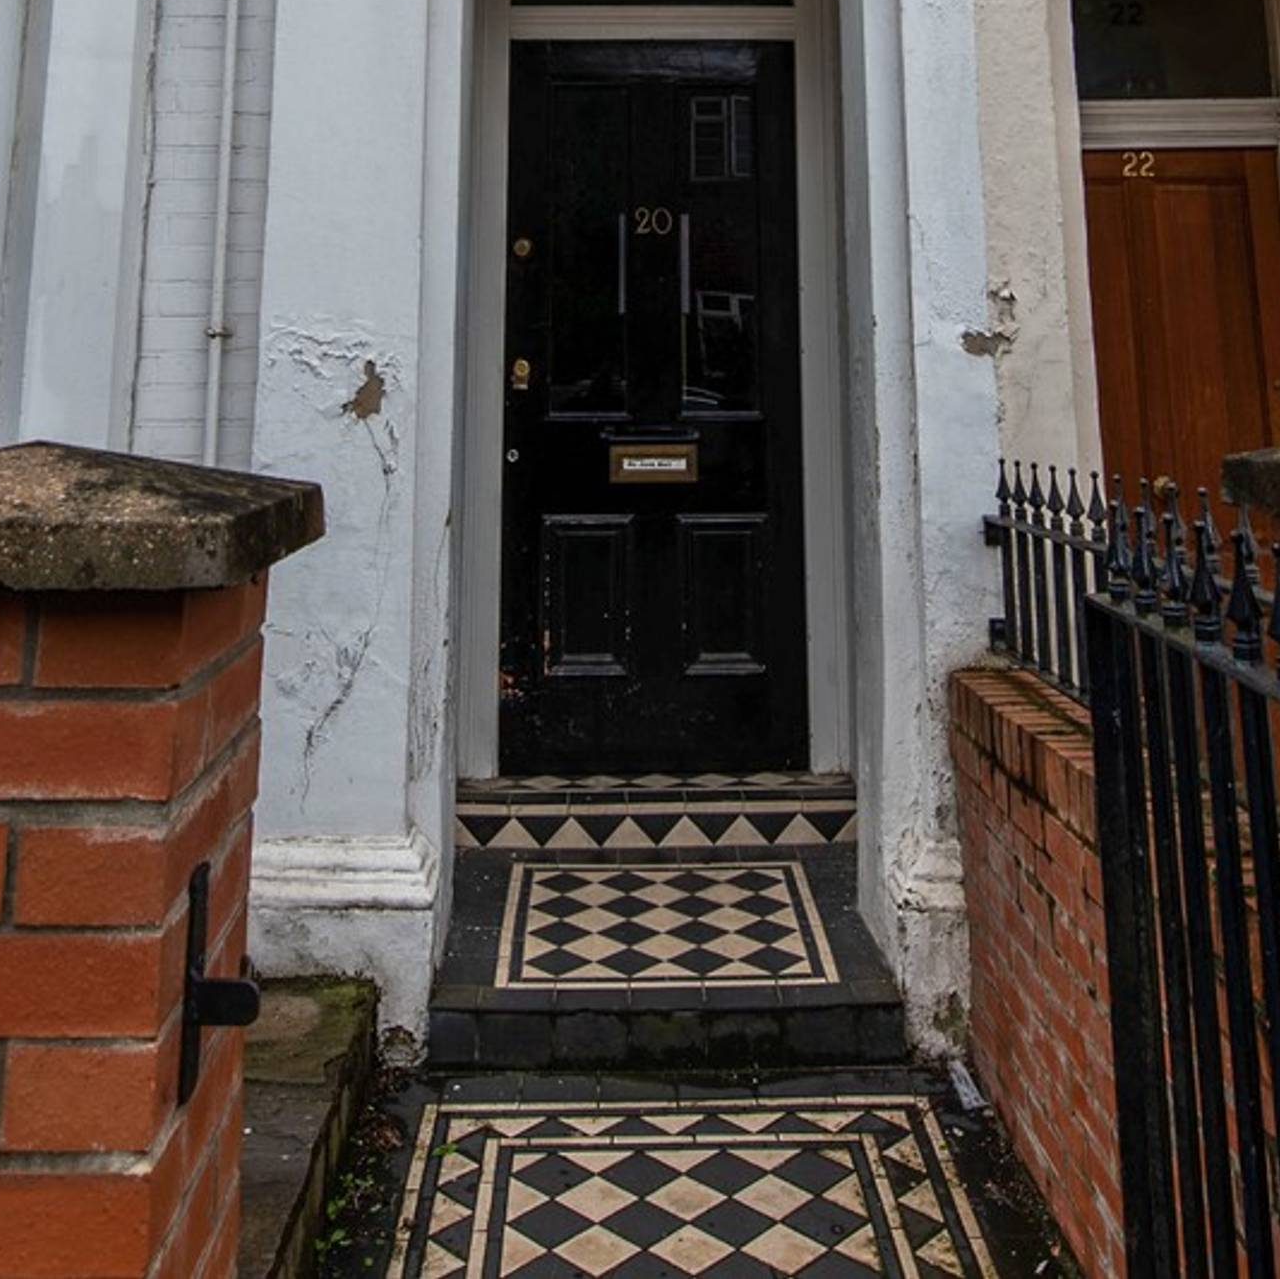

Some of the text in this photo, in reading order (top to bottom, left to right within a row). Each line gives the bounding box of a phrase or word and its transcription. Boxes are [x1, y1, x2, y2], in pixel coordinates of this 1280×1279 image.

[1107, 2, 1144, 27] 22
[1122, 151, 1155, 177] 22
[634, 207, 672, 234] 20
